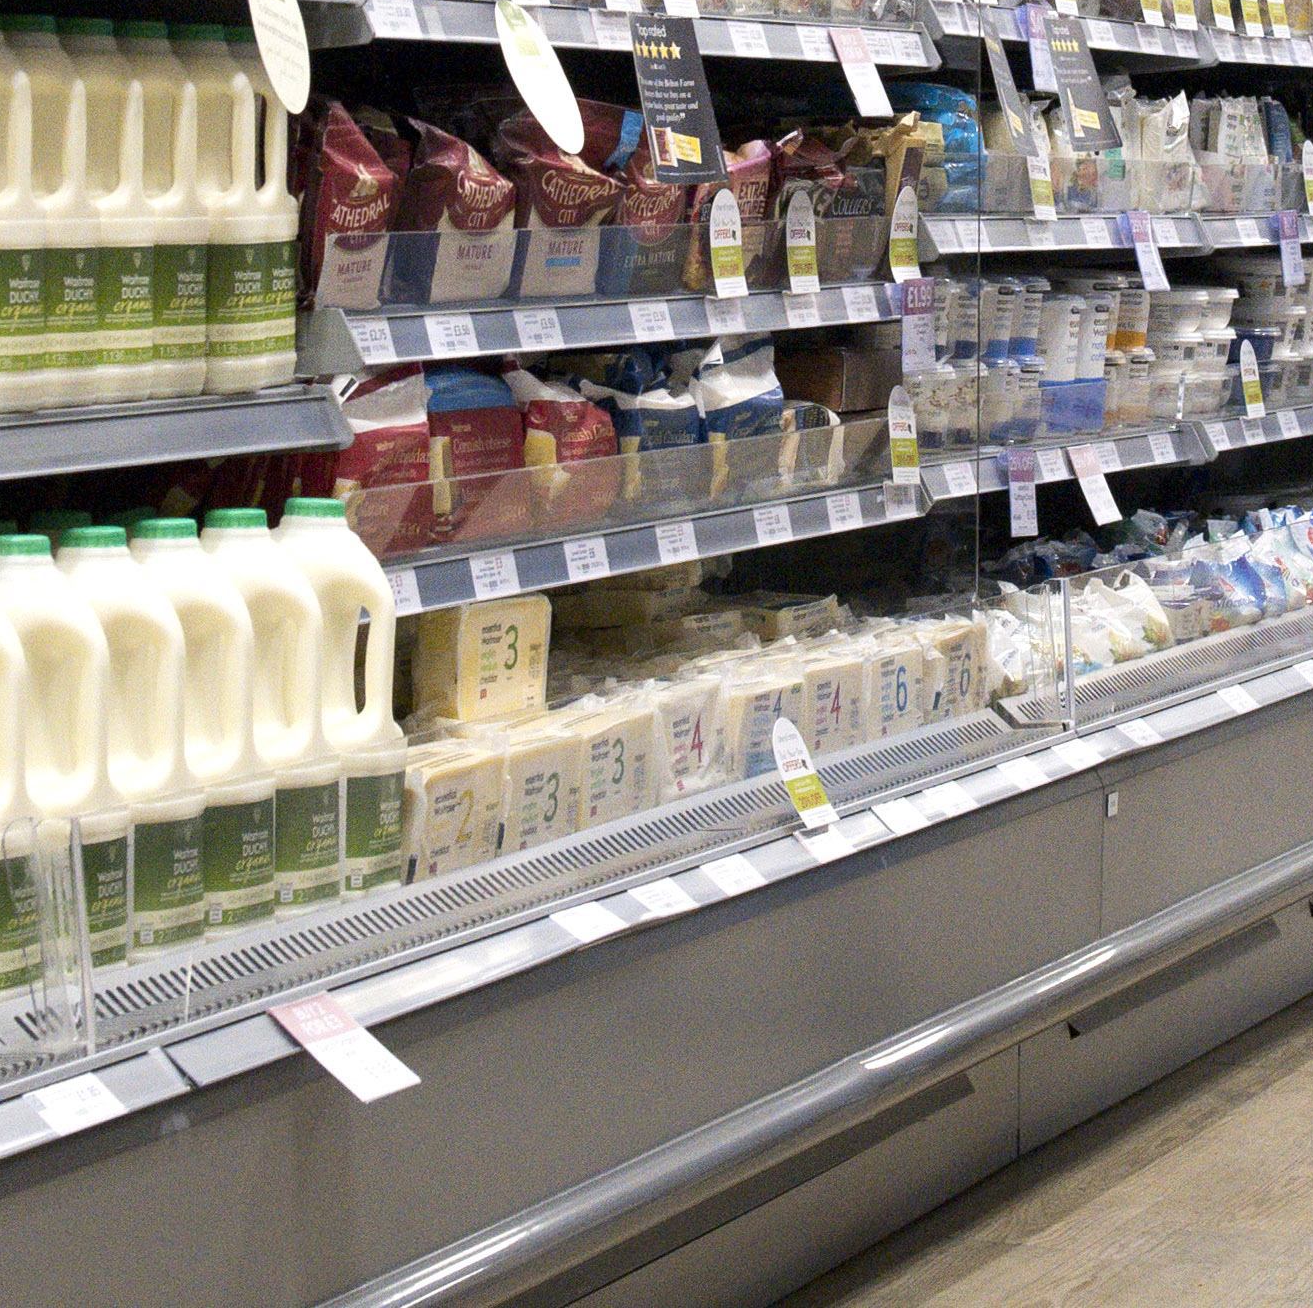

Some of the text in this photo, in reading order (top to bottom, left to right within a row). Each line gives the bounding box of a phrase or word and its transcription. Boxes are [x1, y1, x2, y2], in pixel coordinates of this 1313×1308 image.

[457, 170, 514, 210] CATHEDRA
[542, 169, 620, 207] CATHEDRAL
[467, 211, 489, 228] CITY
[558, 209, 578, 225] CITY
[337, 259, 372, 276] MATURE
[456, 244, 493, 261] MATURE
[547, 240, 584, 257] MATURE
[908, 284, 933, 309] £1.99
[504, 624, 519, 670] 3
[895, 665, 909, 712] 6
[960, 653, 972, 698] 6
[830, 681, 842, 724] 4
[691, 714, 704, 764] 4
[612, 738, 624, 785] 3
[543, 772, 560, 822] 3
